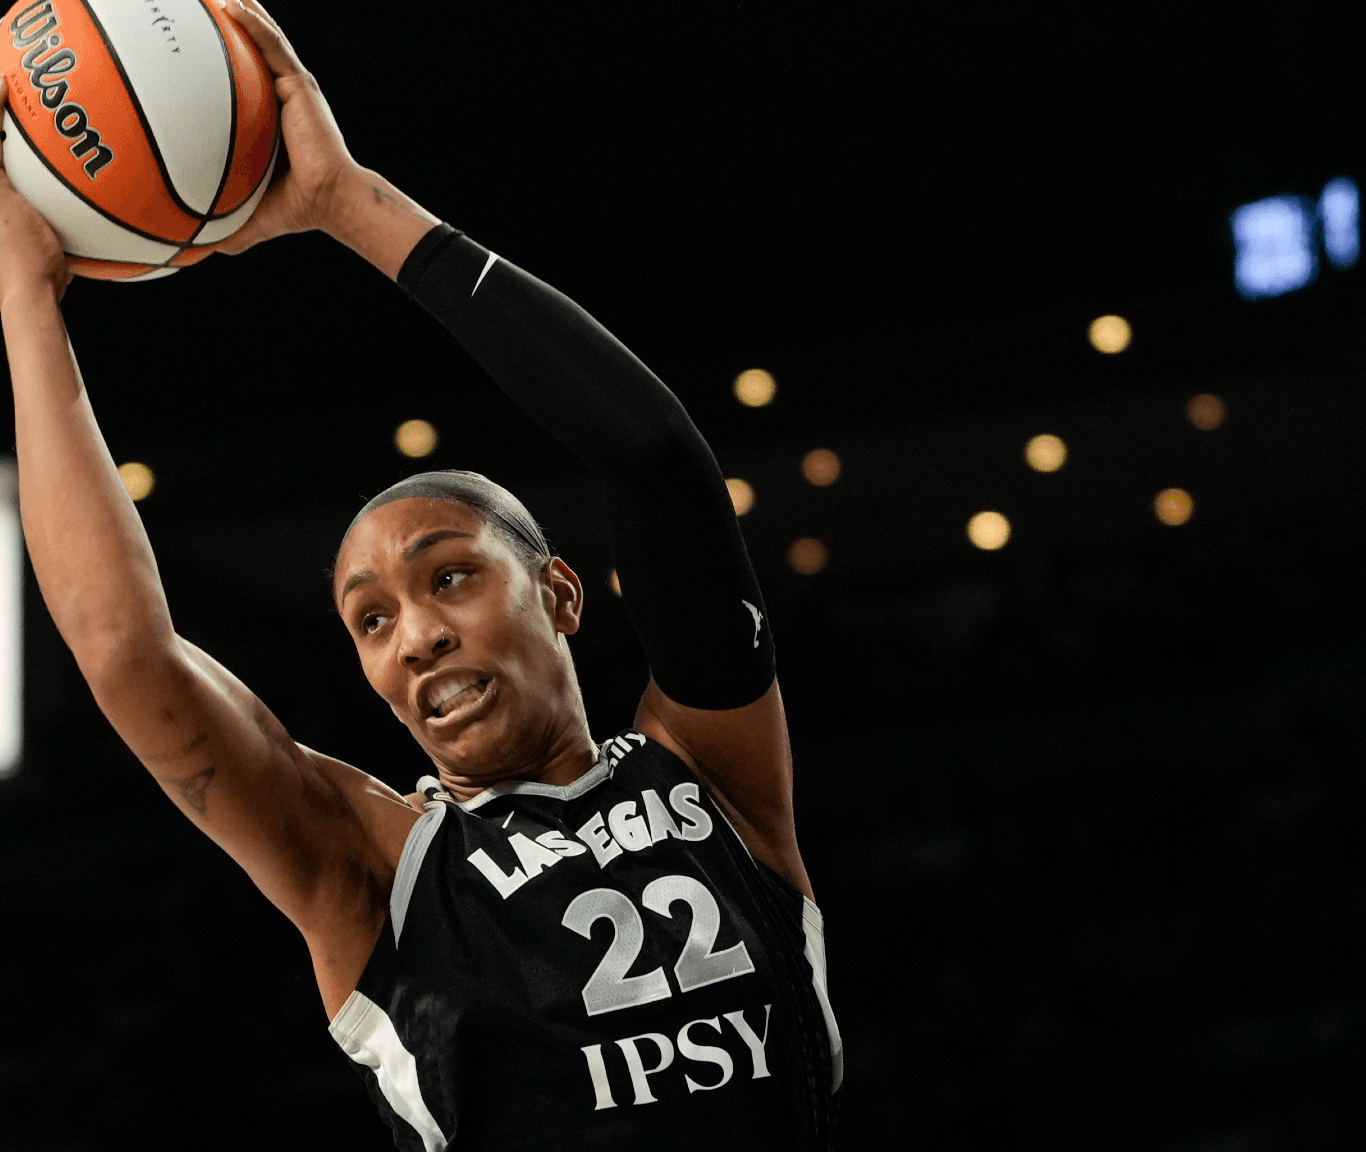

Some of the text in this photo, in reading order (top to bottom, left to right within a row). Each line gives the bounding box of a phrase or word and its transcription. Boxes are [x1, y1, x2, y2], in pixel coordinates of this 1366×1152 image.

[9, 0, 114, 181] Wilson
[467, 782, 713, 900] LAS EGAS
[561, 875, 755, 1017] 22
[580, 1004, 773, 1111] IPSY
